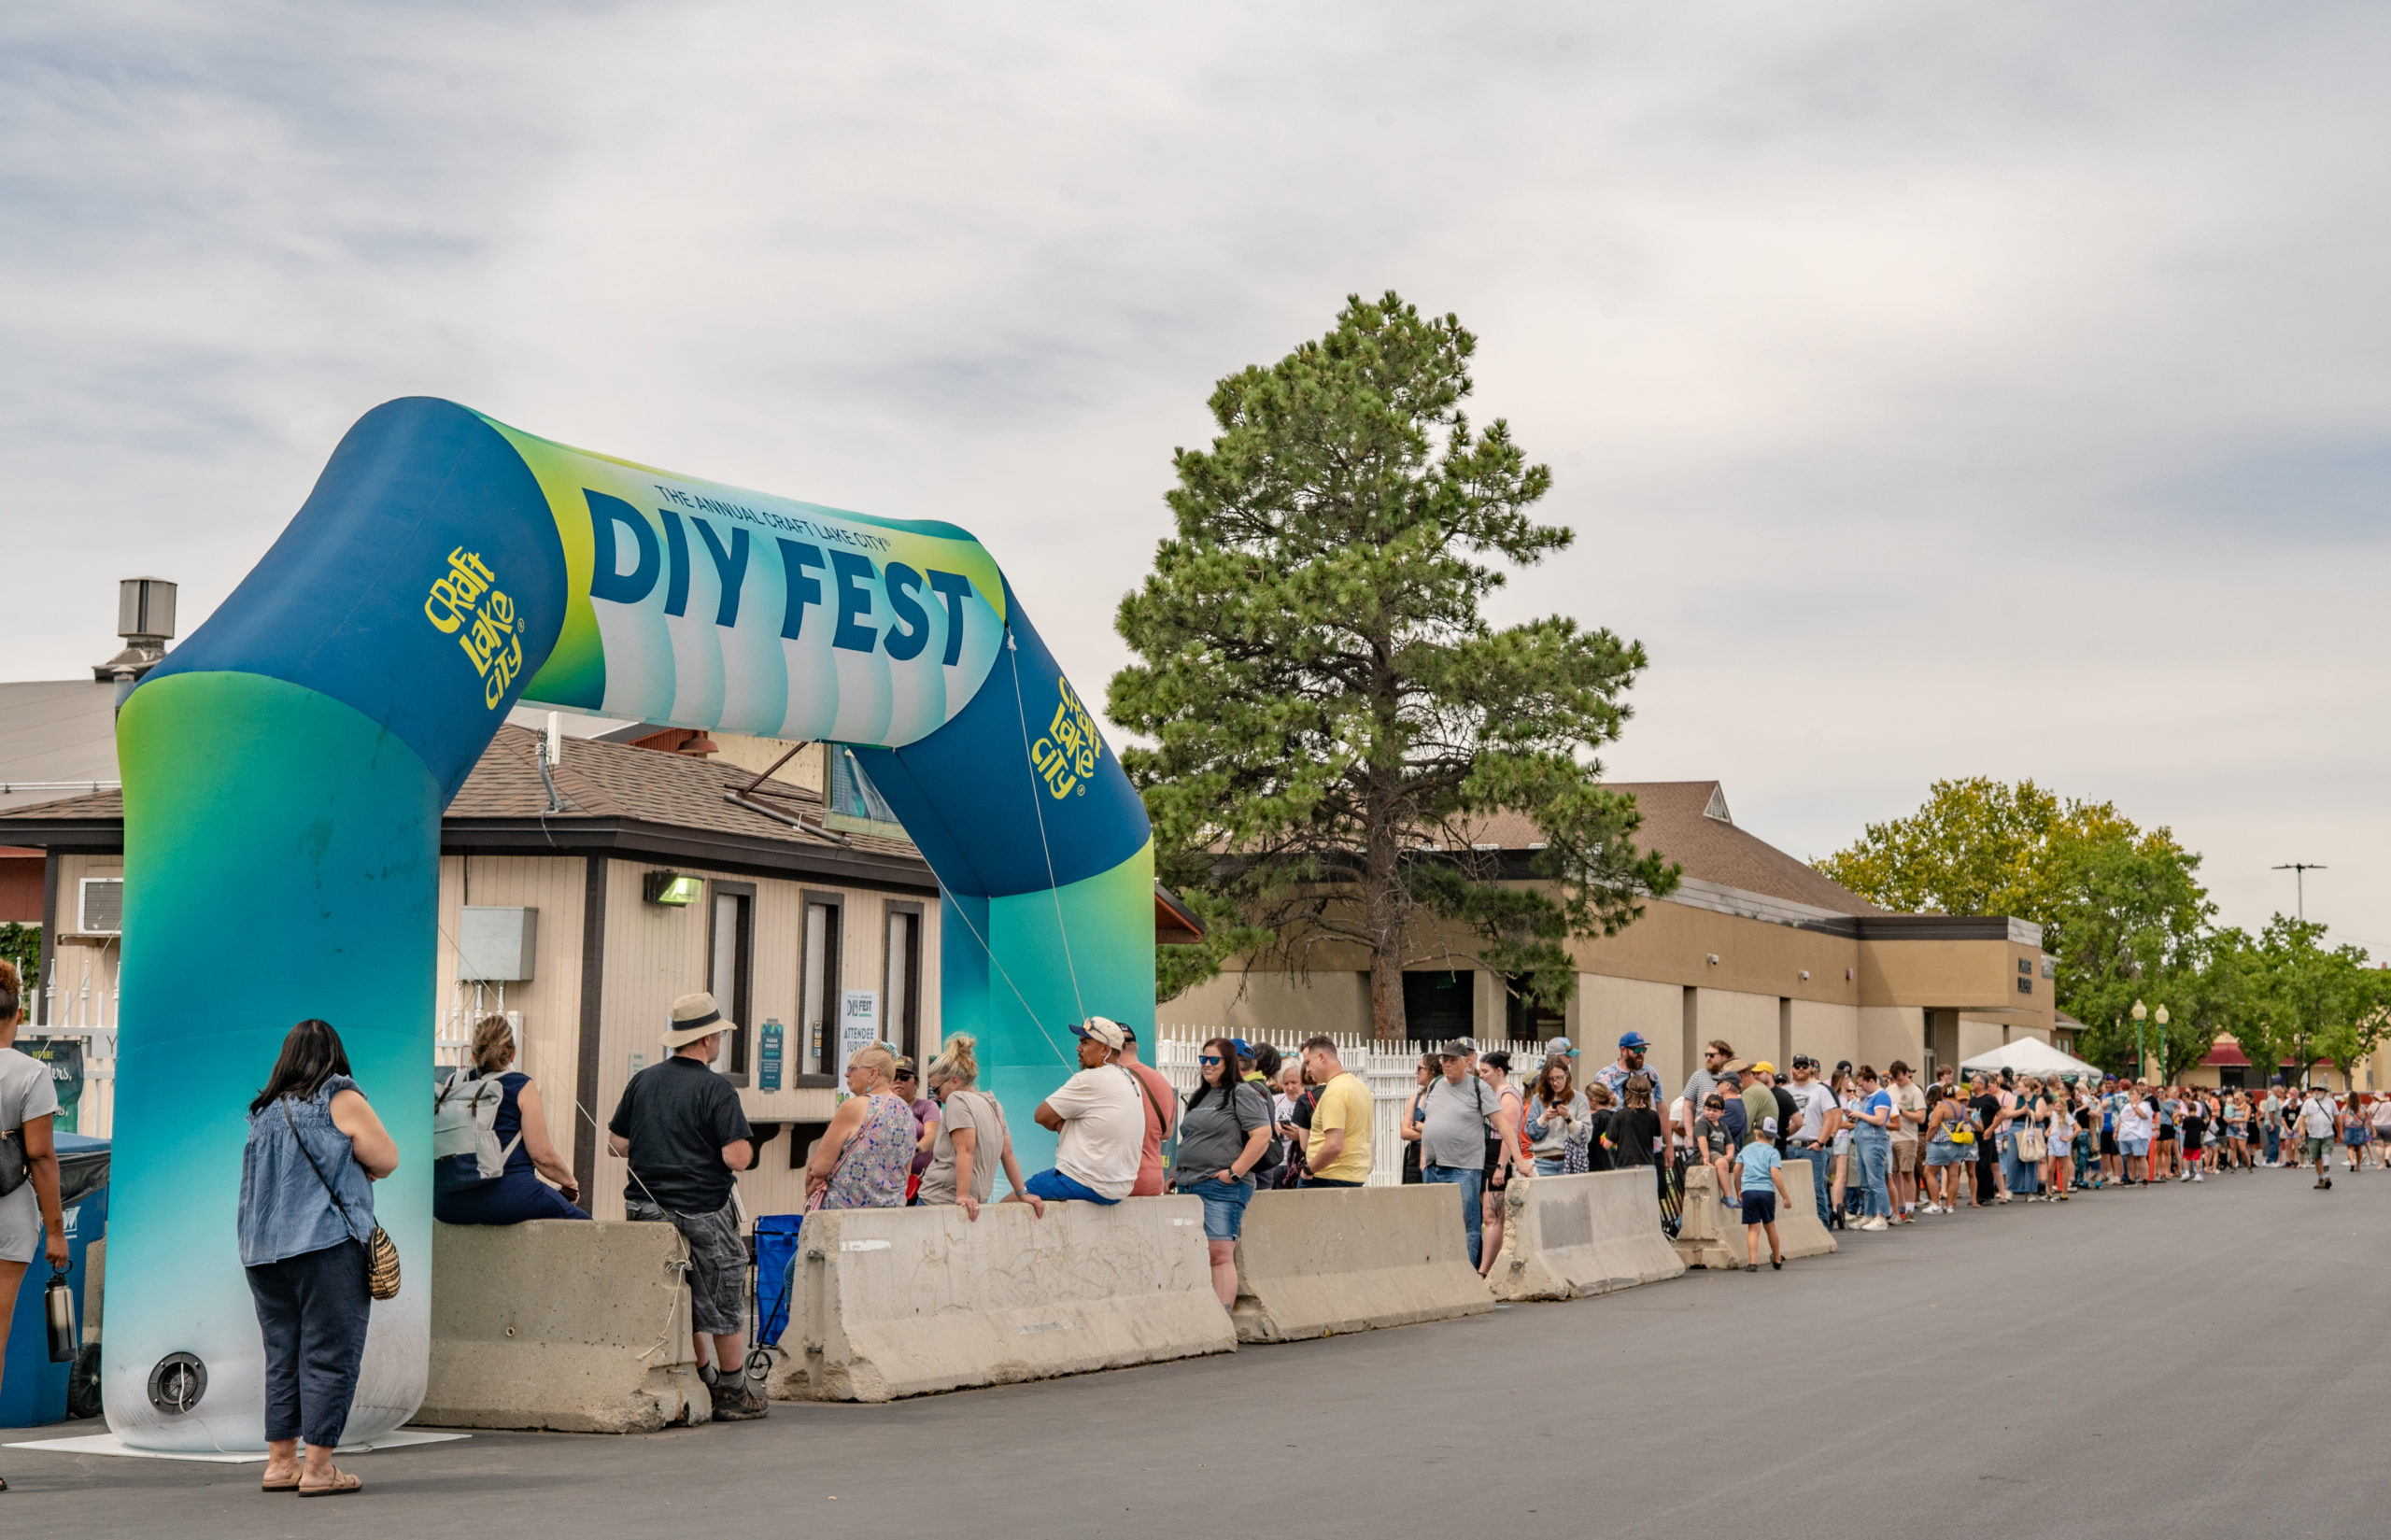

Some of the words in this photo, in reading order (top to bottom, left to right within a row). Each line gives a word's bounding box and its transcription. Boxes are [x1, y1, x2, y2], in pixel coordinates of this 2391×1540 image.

[655, 485, 694, 507] THE
[694, 496, 766, 525] ANNUAL
[762, 512, 815, 537] CRAFT
[814, 523, 856, 545] LAKE
[582, 487, 749, 629] DIY
[776, 537, 973, 667] FEST
[858, 1000, 872, 1011] FEST
[843, 1027, 874, 1039] ATTENDEE
